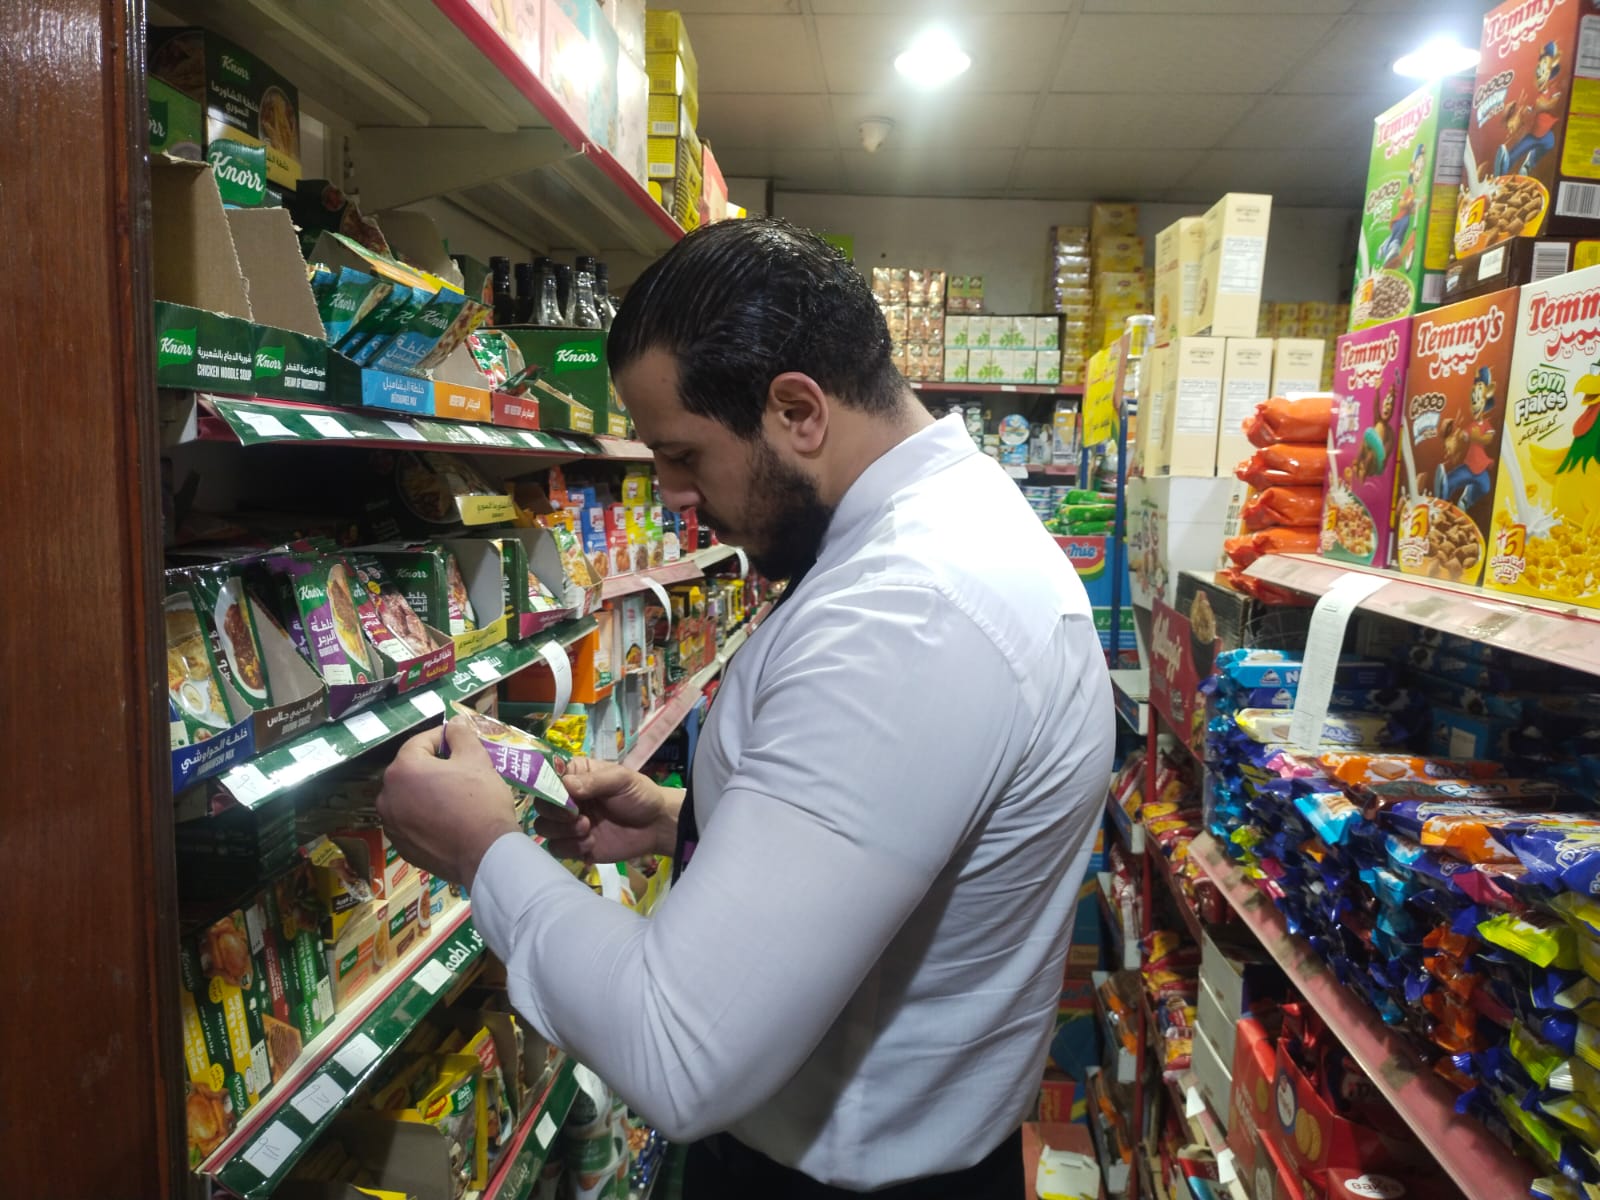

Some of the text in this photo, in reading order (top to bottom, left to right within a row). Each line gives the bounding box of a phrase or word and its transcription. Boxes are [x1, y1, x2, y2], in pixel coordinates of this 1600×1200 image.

[1487, 0, 1566, 46] Temmy
[221, 55, 251, 81] Knorr
[1377, 95, 1432, 147] Temmy's
[210, 152, 264, 192] Knorr
[419, 310, 449, 330] Knorr
[1418, 306, 1504, 357] Temmy's
[160, 337, 193, 357] Knorr
[255, 354, 283, 370] Knorr
[556, 349, 598, 363] Knorr
[1341, 331, 1399, 371] Temmy's
[197, 363, 252, 381] CHICKEN NOODLE SOUP
[1526, 368, 1566, 394] Corn
[1410, 393, 1446, 417] CHOCO
[1514, 391, 1568, 428] Flakes
[395, 568, 428, 579] Knorr
[180, 728, 248, 774] خلطة الحواوشي
[302, 1002, 315, 1039] Knorr
[234, 1074, 246, 1116] Knorr
